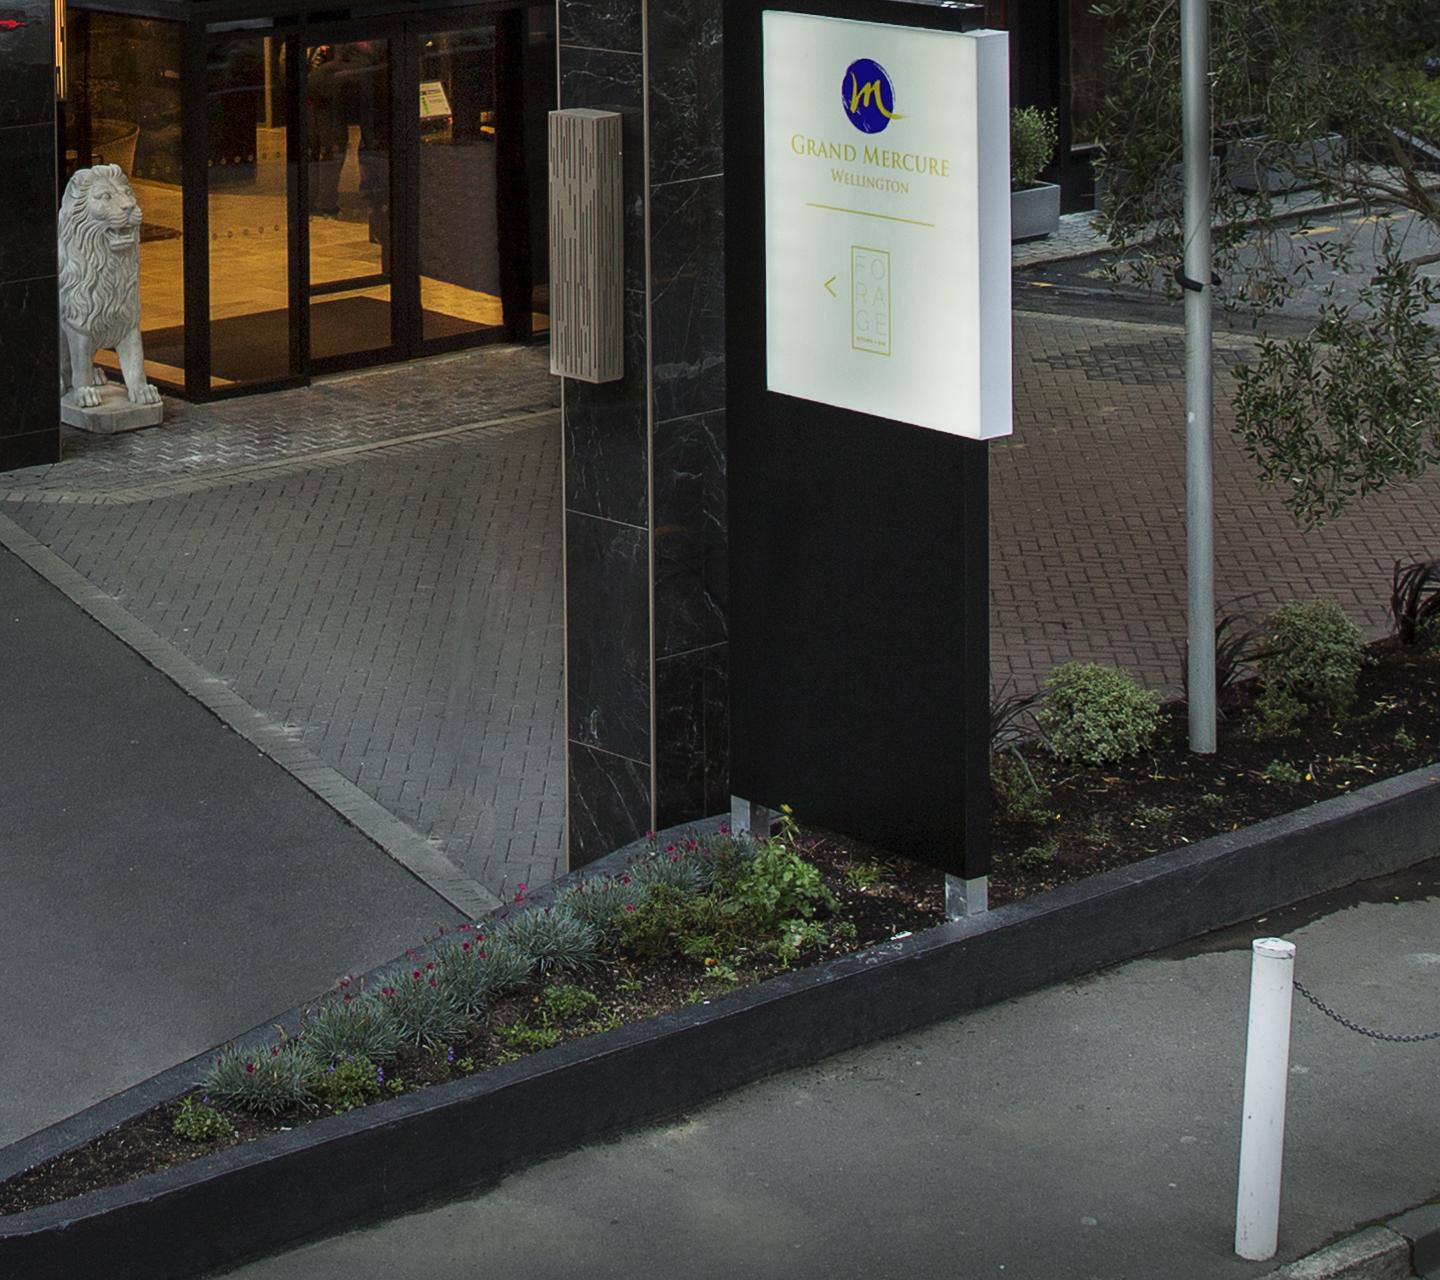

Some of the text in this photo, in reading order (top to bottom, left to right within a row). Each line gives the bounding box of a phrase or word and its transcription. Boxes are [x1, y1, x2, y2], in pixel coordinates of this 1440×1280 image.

[791, 134, 950, 178] GRAND MERCURE
[831, 168, 910, 194] WELLINGTON
